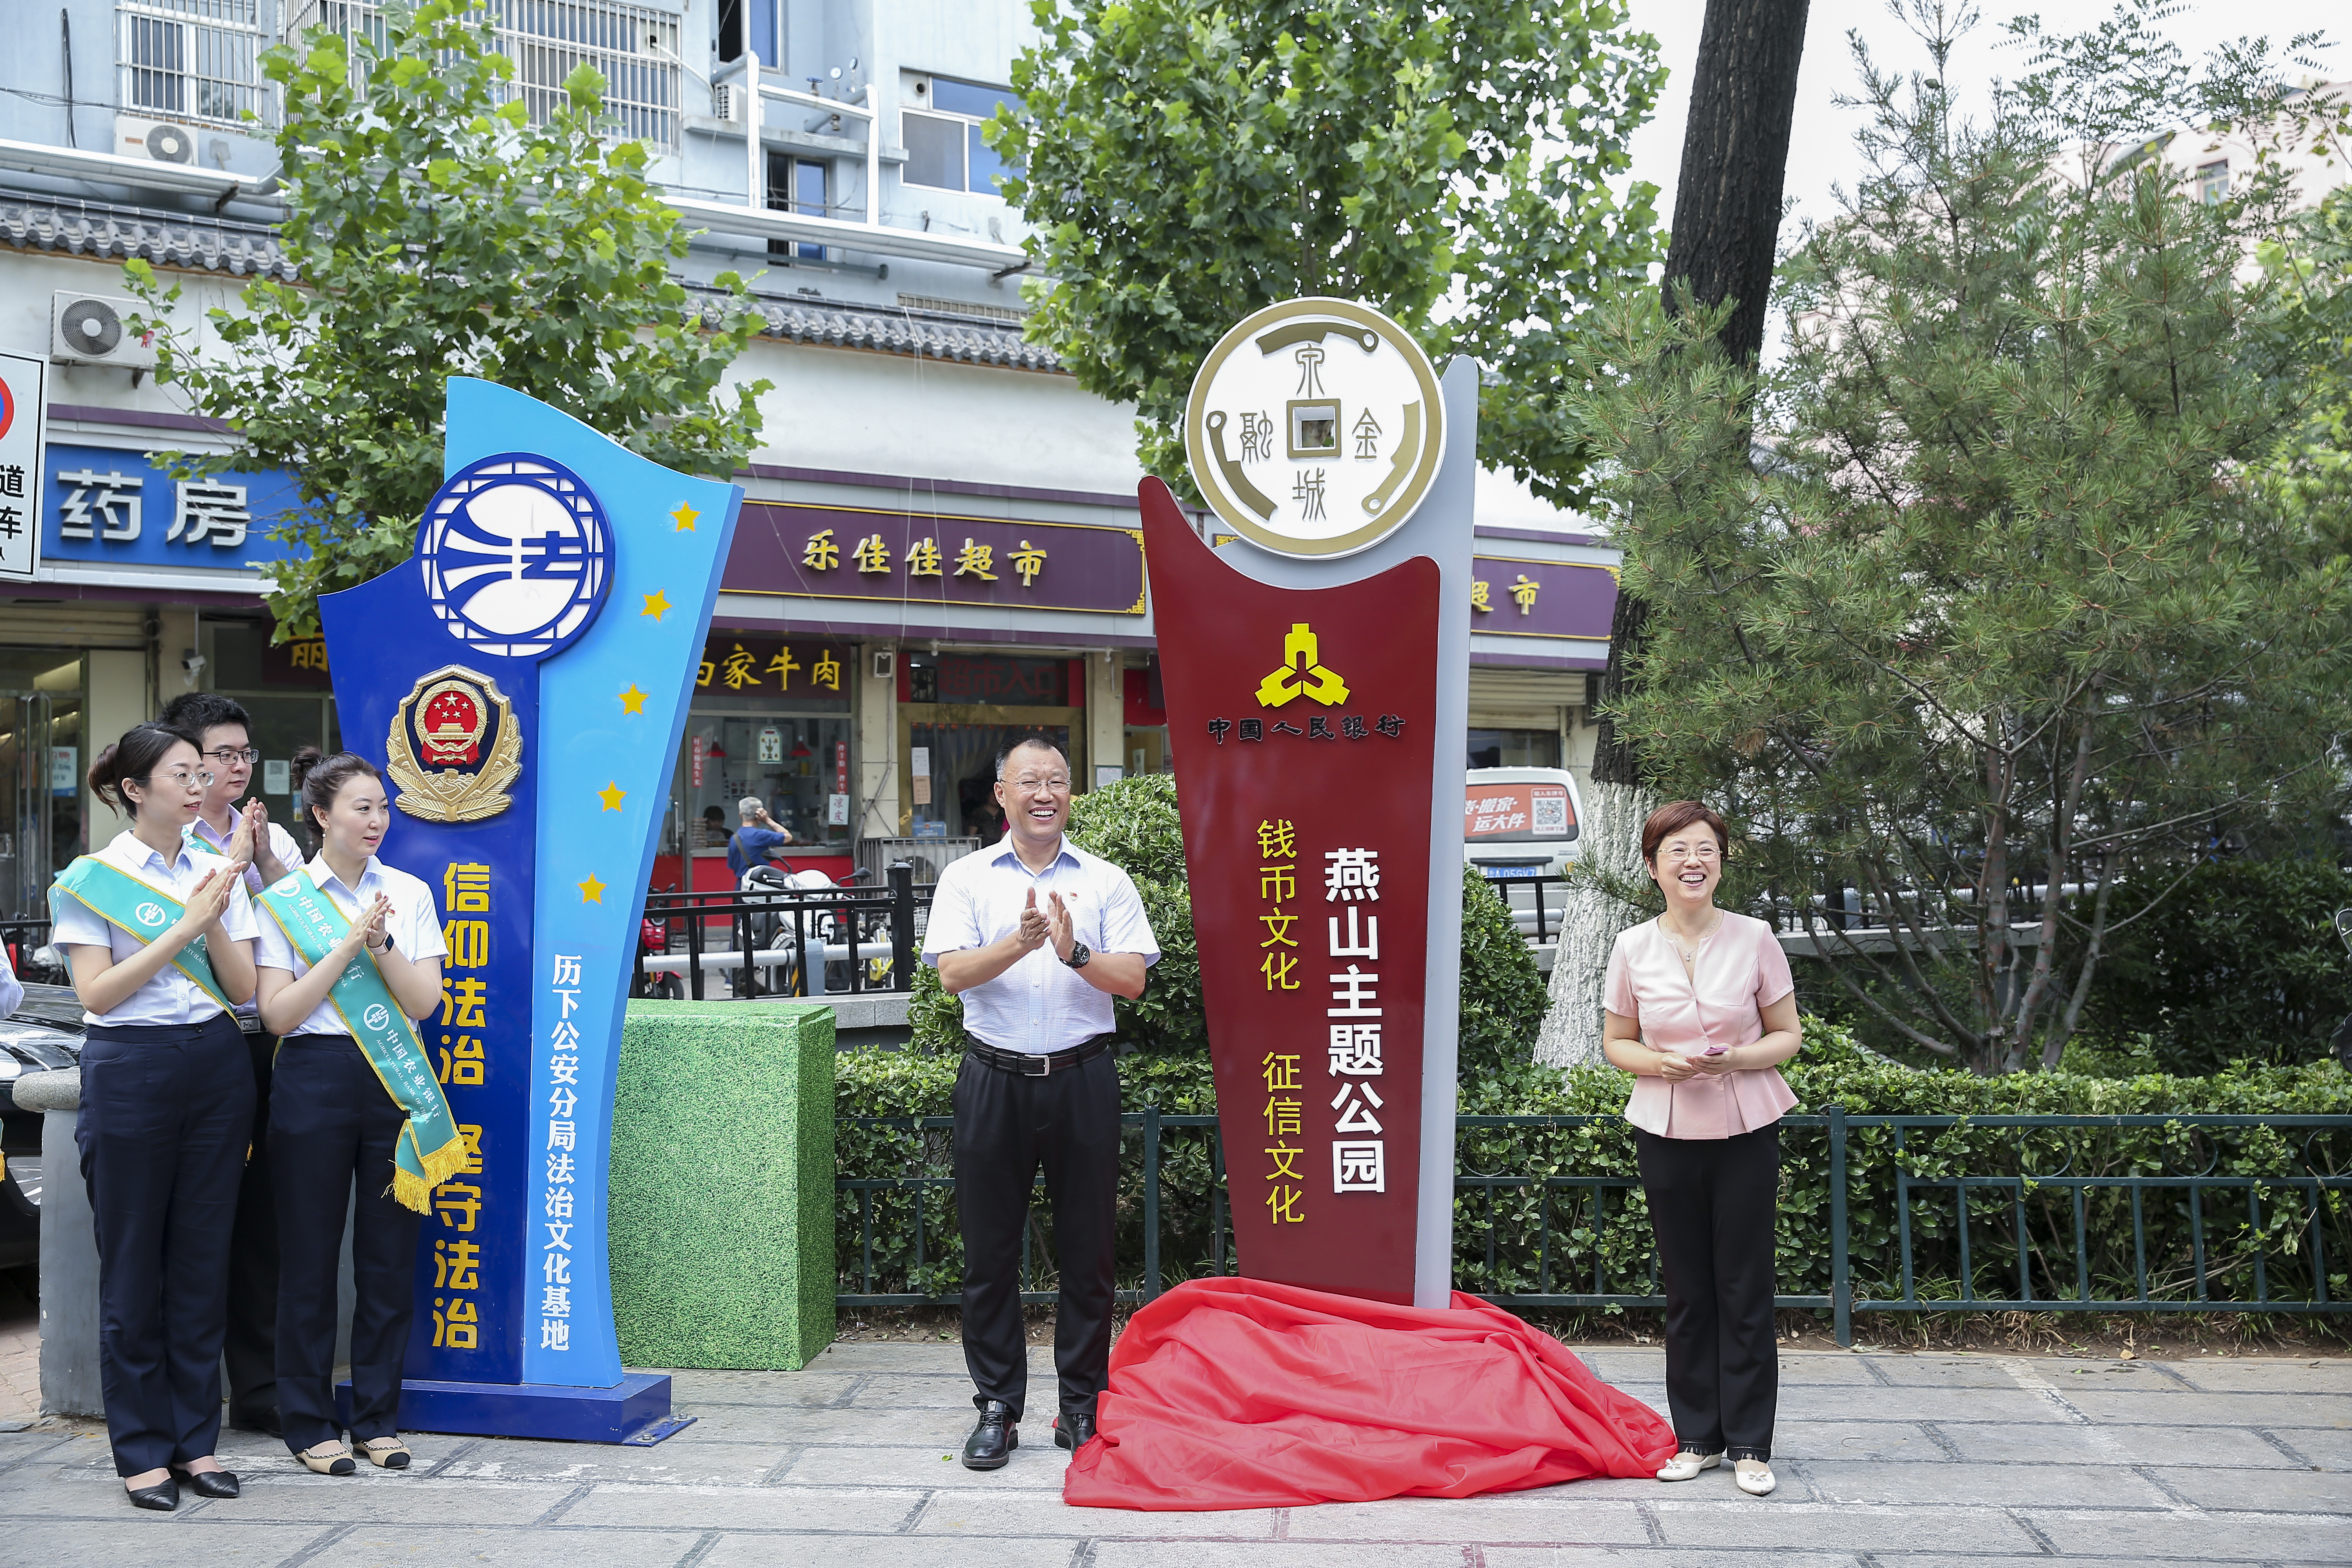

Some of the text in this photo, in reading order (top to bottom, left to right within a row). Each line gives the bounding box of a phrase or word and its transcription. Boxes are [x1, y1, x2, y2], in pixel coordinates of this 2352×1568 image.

[58, 469, 251, 546] 药房
[802, 528, 1047, 587] 乐佳佳超市
[937, 657, 1061, 697] 超市入口
[833, 797, 844, 822] 凉皮
[1472, 812, 1527, 833] 运大件
[316, 942, 327, 957] BAN
[439, 862, 490, 1085] 信仰法治
[1257, 819, 1305, 1225] 钱币文化 征信文化
[1324, 847, 1386, 1195] 燕山主题公园
[376, 1038, 404, 1081] AGRICULTURAL
[403, 1080, 416, 1097] BANK
[415, 1097, 423, 1105] OF
[386, 1029, 441, 1118] 中国农业银行
[540, 954, 583, 1351] 历下公安分局法治文化基地
